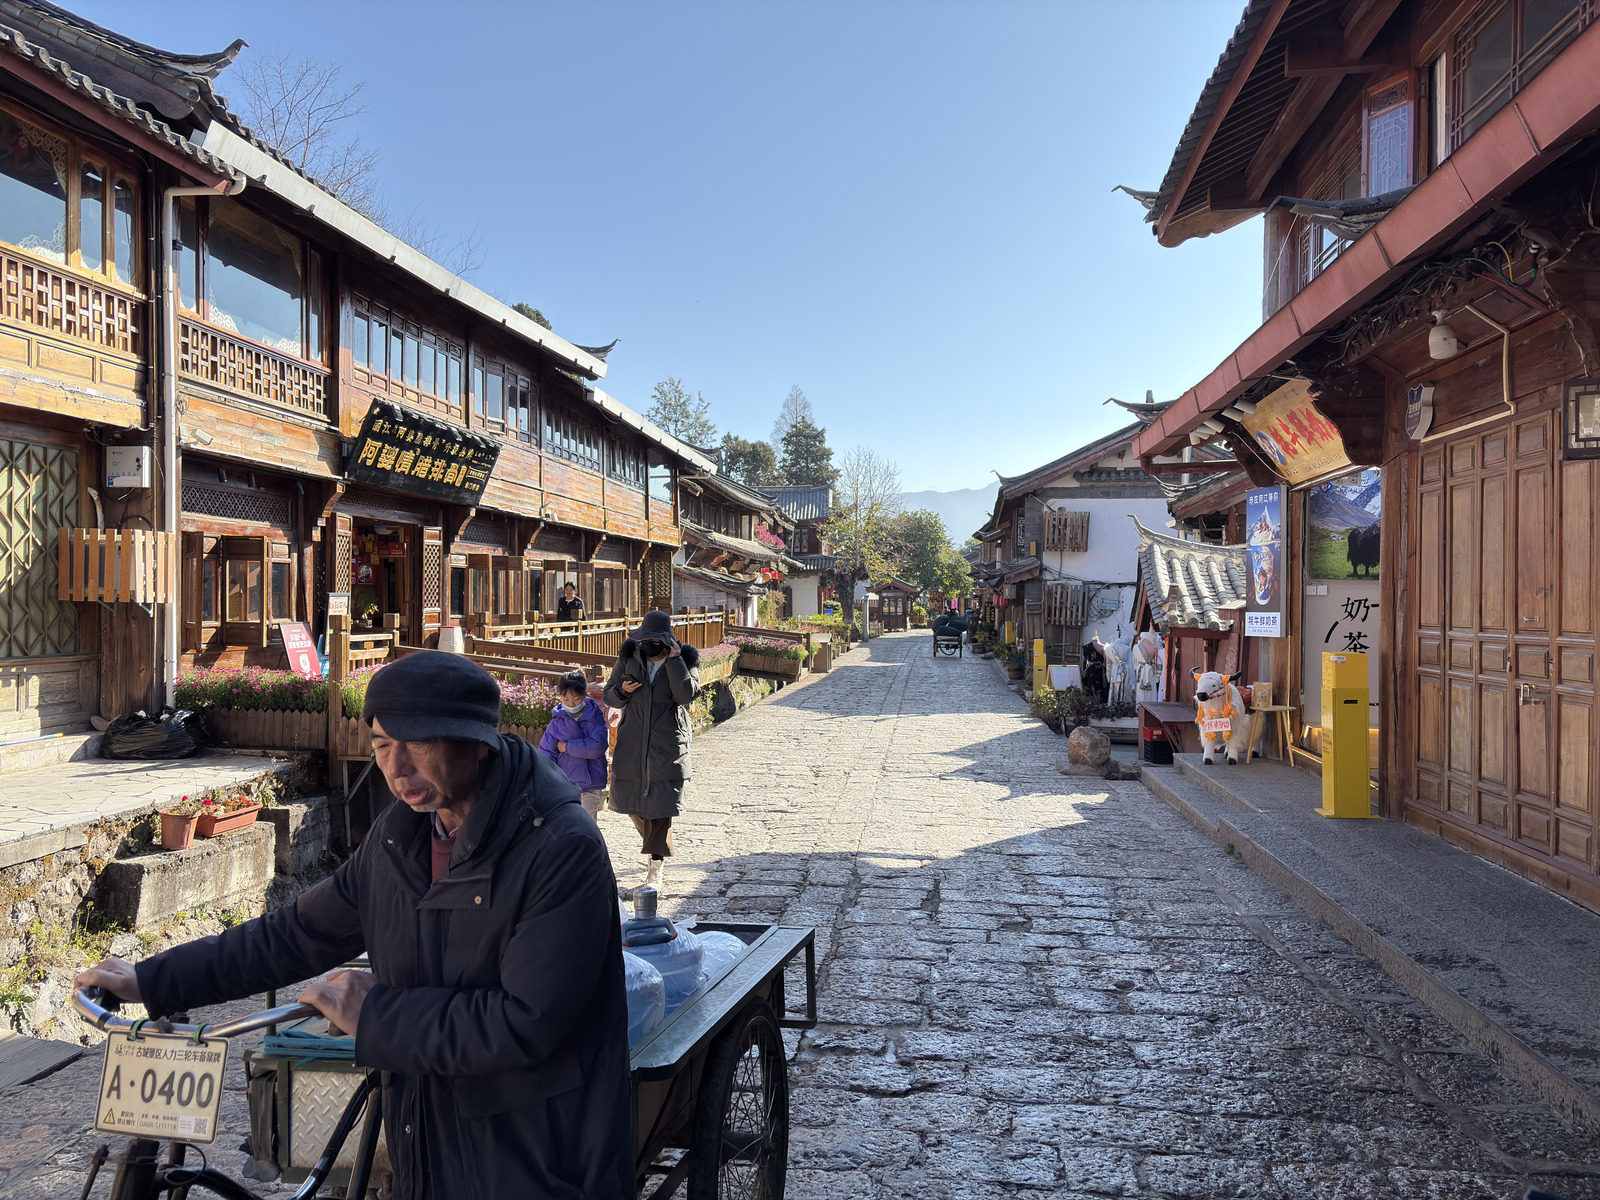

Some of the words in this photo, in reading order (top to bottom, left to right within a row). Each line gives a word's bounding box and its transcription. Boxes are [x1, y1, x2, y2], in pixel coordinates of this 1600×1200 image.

[1266, 395, 1341, 460] 牦牛鲜奶
[1248, 616, 1277, 625] 牦牛鲜奶茶
[136, 1046, 221, 1063] 古城景区人力三轮车备案牌
